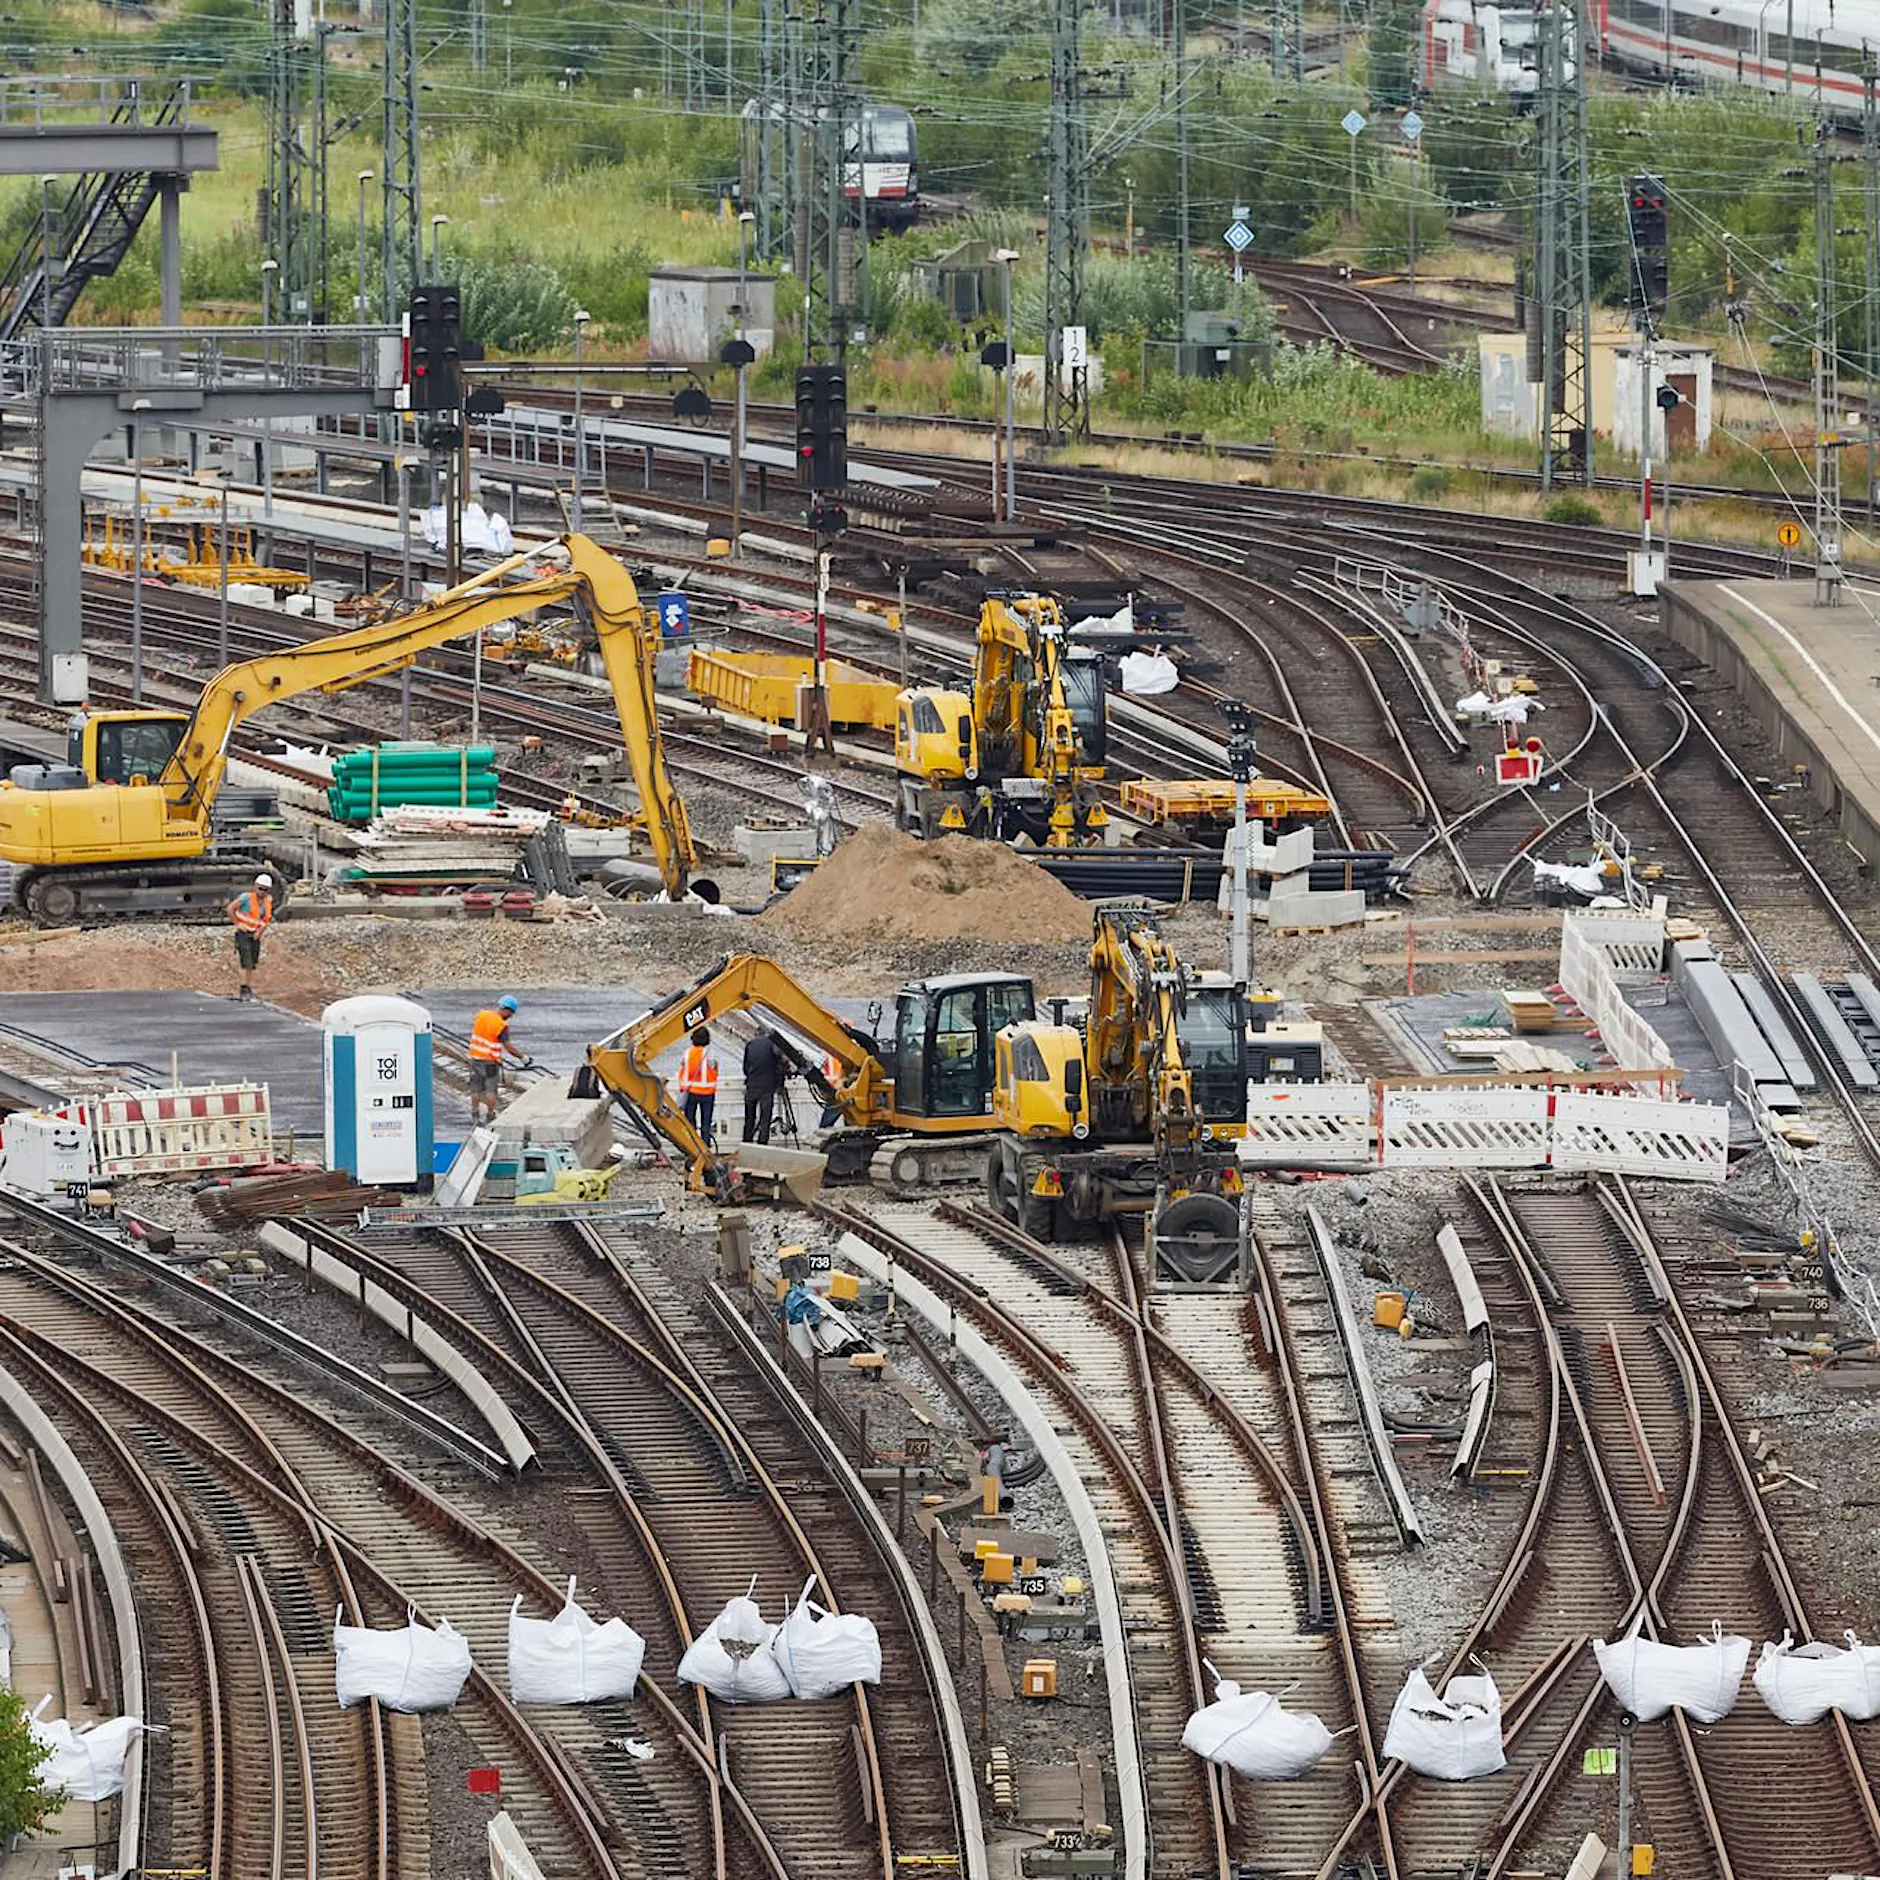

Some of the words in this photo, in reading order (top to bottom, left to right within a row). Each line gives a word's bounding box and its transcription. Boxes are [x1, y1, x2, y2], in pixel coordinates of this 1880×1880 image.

[1073, 330, 1077, 345] 1
[1070, 346, 1079, 362] 2
[685, 1006, 704, 1027] CAT
[377, 1068, 397, 1079] TOI
[68, 1184, 86, 1196] 741
[810, 1256, 830, 1269] 738
[1802, 1266, 1823, 1279] 740
[1809, 1297, 1829, 1310] 736
[907, 1441, 928, 1454] 737
[1022, 1579, 1045, 1593] 735
